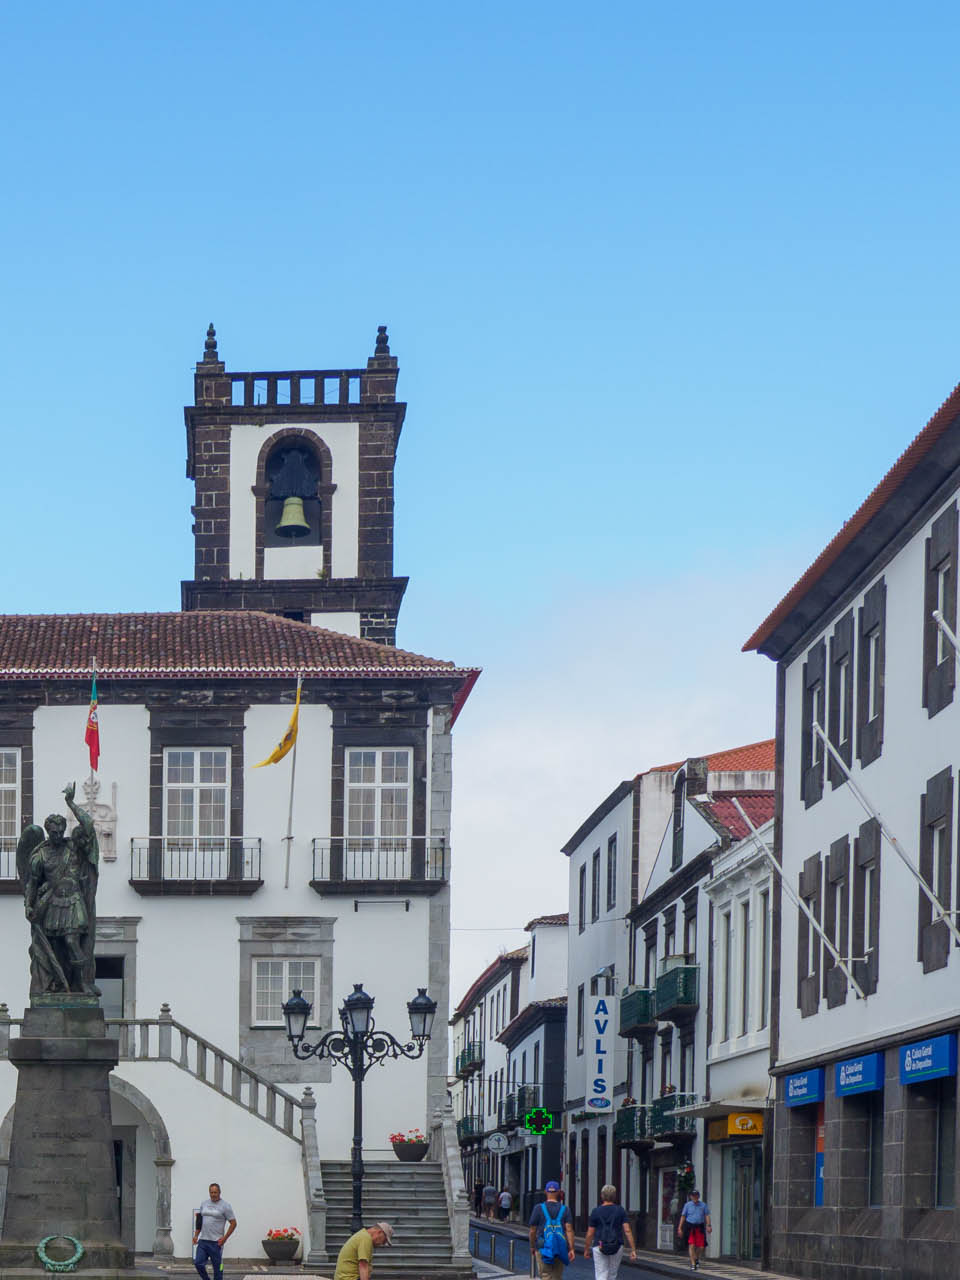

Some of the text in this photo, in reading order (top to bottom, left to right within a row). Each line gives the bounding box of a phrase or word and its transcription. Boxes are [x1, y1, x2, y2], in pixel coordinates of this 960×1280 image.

[592, 999, 609, 1095] AVLIS
[911, 1044, 932, 1059] Caixa Geral
